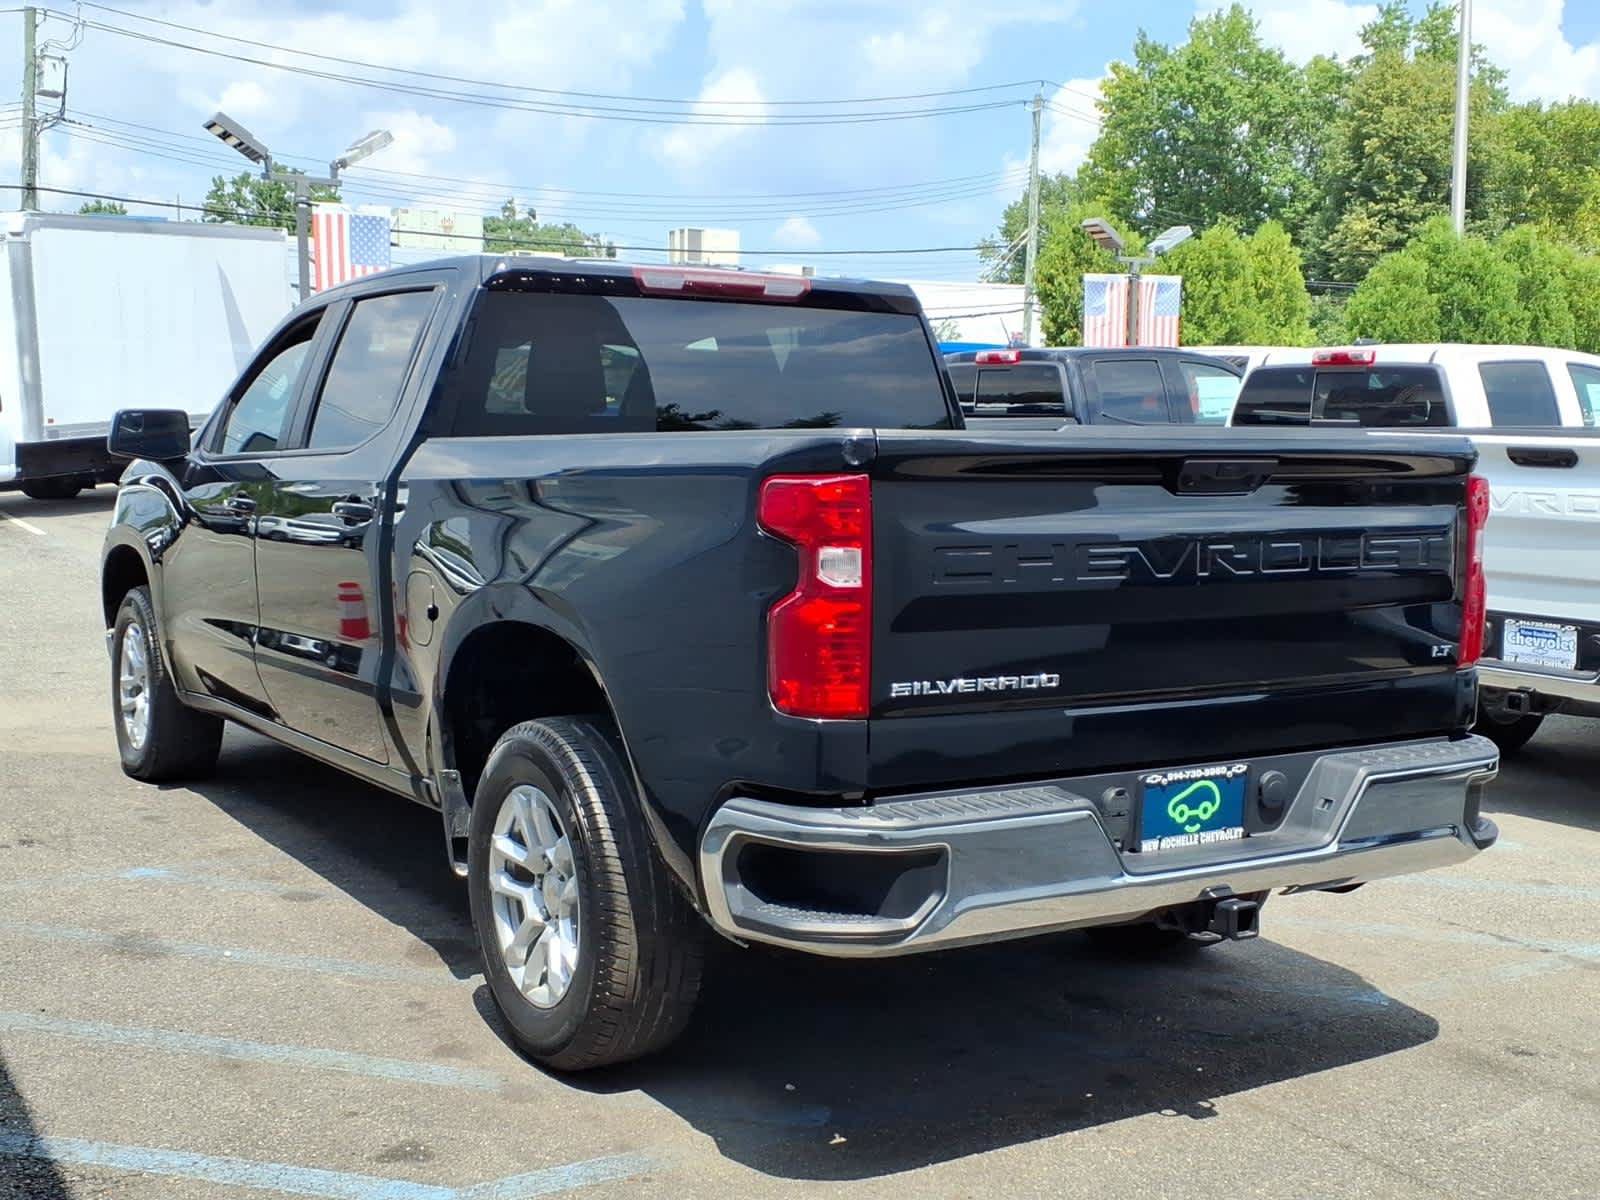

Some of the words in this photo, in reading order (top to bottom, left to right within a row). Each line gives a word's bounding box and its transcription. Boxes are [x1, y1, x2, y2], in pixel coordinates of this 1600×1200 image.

[930, 533, 1446, 585] CHEVROLET
[1431, 644, 1453, 657] LT
[890, 673, 1060, 697] SILVERADO
[1141, 838, 1159, 853] NEW
[1199, 826, 1244, 845] CHEVROLET
